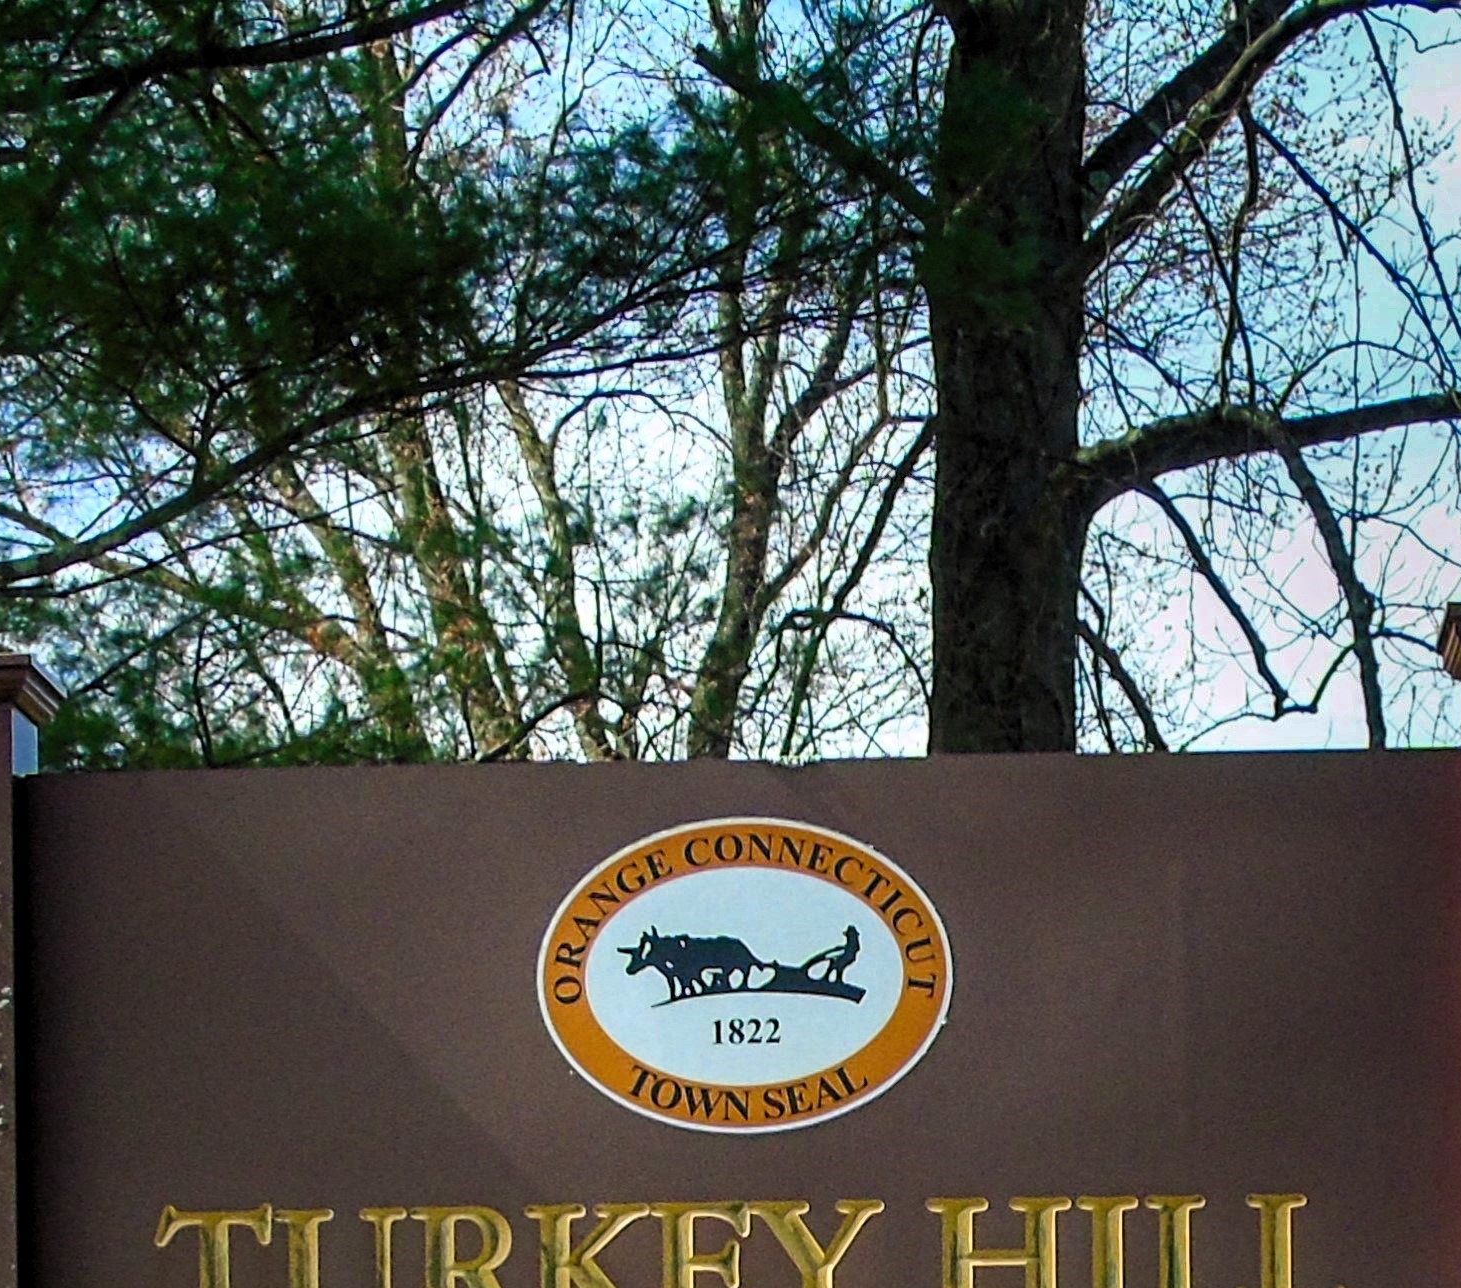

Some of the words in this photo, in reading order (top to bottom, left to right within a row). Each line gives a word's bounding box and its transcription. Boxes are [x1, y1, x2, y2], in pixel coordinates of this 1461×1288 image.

[553, 848, 673, 1005] ORANGE
[683, 832, 937, 998] CONNECTICUT
[711, 1017, 782, 1046] 1822
[627, 1065, 750, 1121] TOWN
[763, 1066, 869, 1120] SEAL
